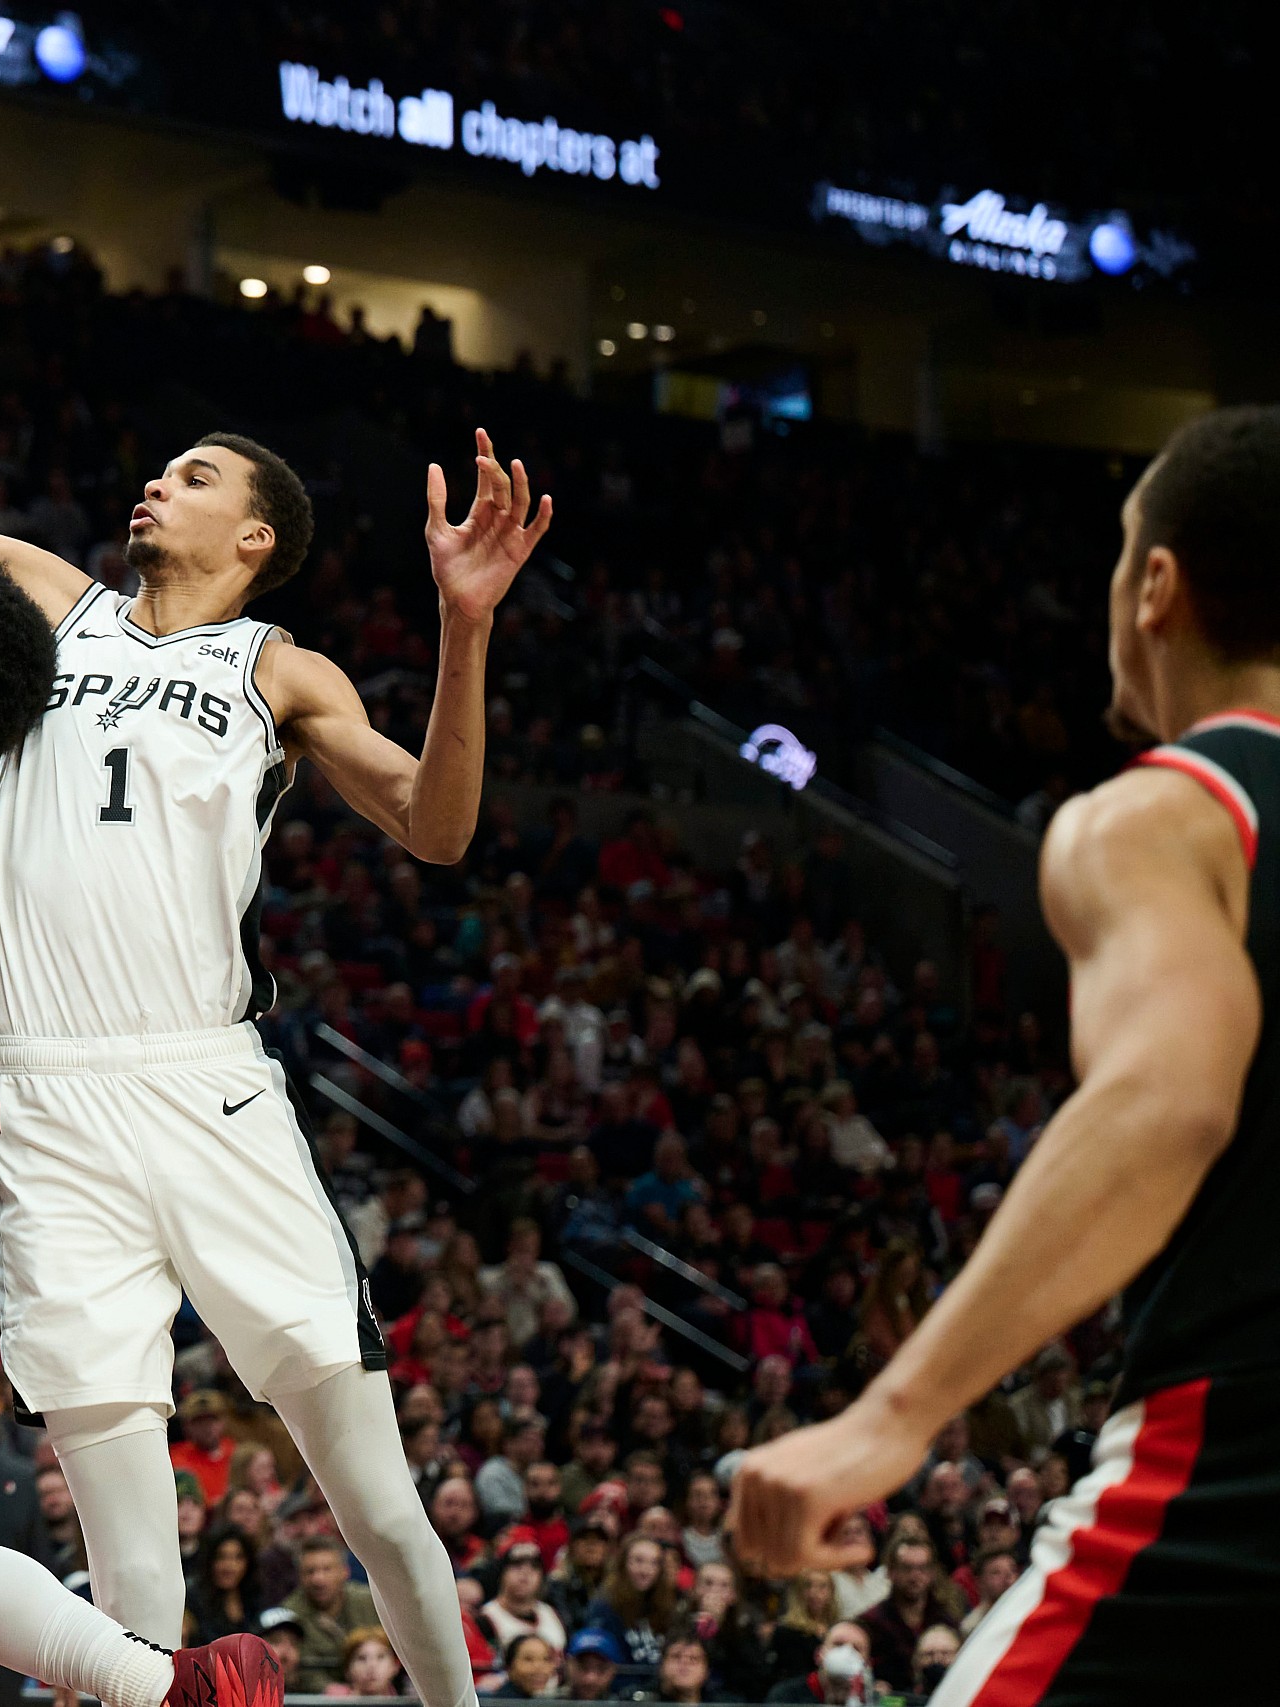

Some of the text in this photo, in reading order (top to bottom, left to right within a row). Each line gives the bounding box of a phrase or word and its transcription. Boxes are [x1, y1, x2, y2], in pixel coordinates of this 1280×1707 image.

[280, 60, 660, 190] Watch all chapters at
[197, 644, 239, 668] Self.
[45, 673, 231, 738] SPURS
[97, 747, 134, 823] 1
